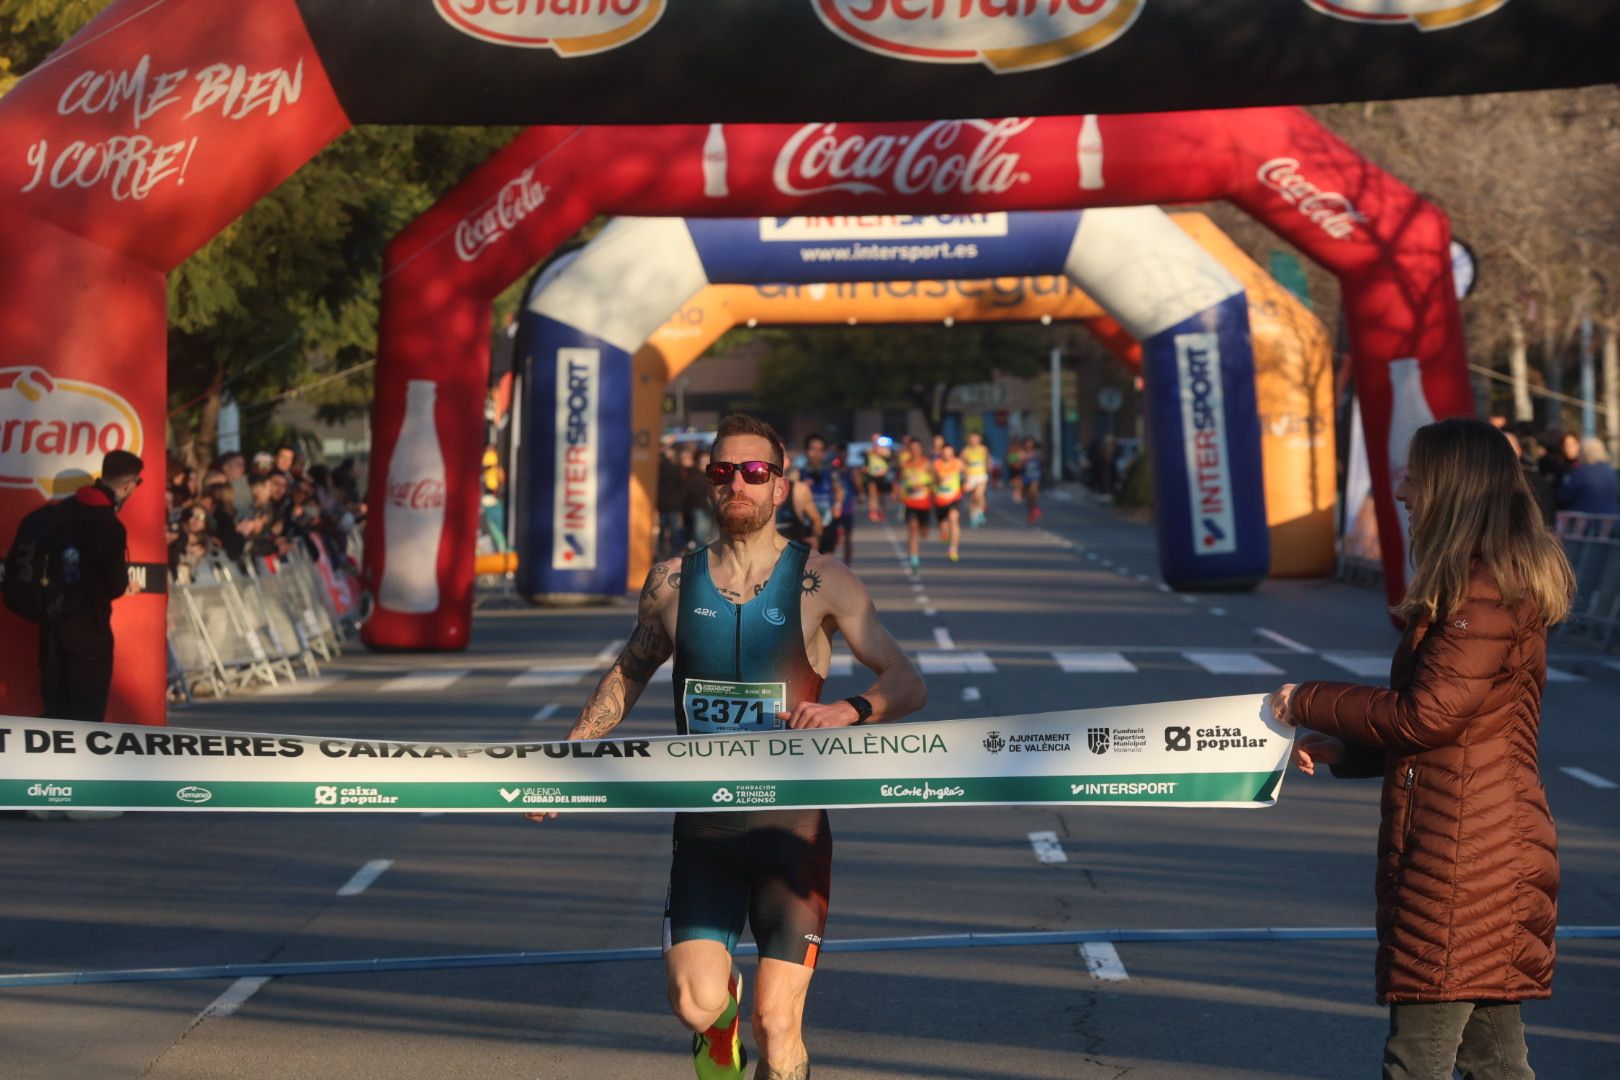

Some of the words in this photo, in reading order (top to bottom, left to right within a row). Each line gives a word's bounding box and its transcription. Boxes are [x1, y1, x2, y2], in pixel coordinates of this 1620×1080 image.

[57, 54, 188, 130] COME
[181, 57, 304, 121] BIEN
[773, 117, 1036, 196] Coca-Cola
[51, 135, 198, 200] CORRE!
[800, 243, 978, 263] www.intersport.es
[0, 419, 125, 455] rrano
[1187, 346, 1224, 515] INTERSPORT
[563, 360, 590, 530] INTERSPORT
[693, 607, 718, 618] 42K
[691, 698, 764, 725] 2371
[1009, 733, 1071, 743] AJUNTAMENT
[1196, 725, 1242, 737] caixa
[24, 729, 76, 753] DE
[86, 731, 304, 757] CARRERES
[319, 739, 453, 758] CAIXA
[456, 739, 651, 758] POPULAR
[666, 739, 761, 758] CIUTAT
[768, 739, 804, 756] DE
[811, 732, 948, 755] VALÈNCIA
[1009, 744, 1022, 753] DE
[1025, 742, 1071, 752] VALÈNCIA
[1196, 736, 1268, 751] popular
[27, 783, 73, 797] divina
[340, 786, 378, 795] caixa
[523, 787, 562, 795] VALENCIA
[736, 790, 776, 798] TRINIDAD
[880, 784, 894, 796] El
[893, 785, 922, 796] Corte
[922, 781, 965, 800] Inglés
[1085, 782, 1177, 796] INTERSPORT
[340, 795, 399, 805] popular
[522, 795, 555, 803] CIUDAD
[555, 795, 571, 803] DEL
[571, 795, 608, 803] RUNNING
